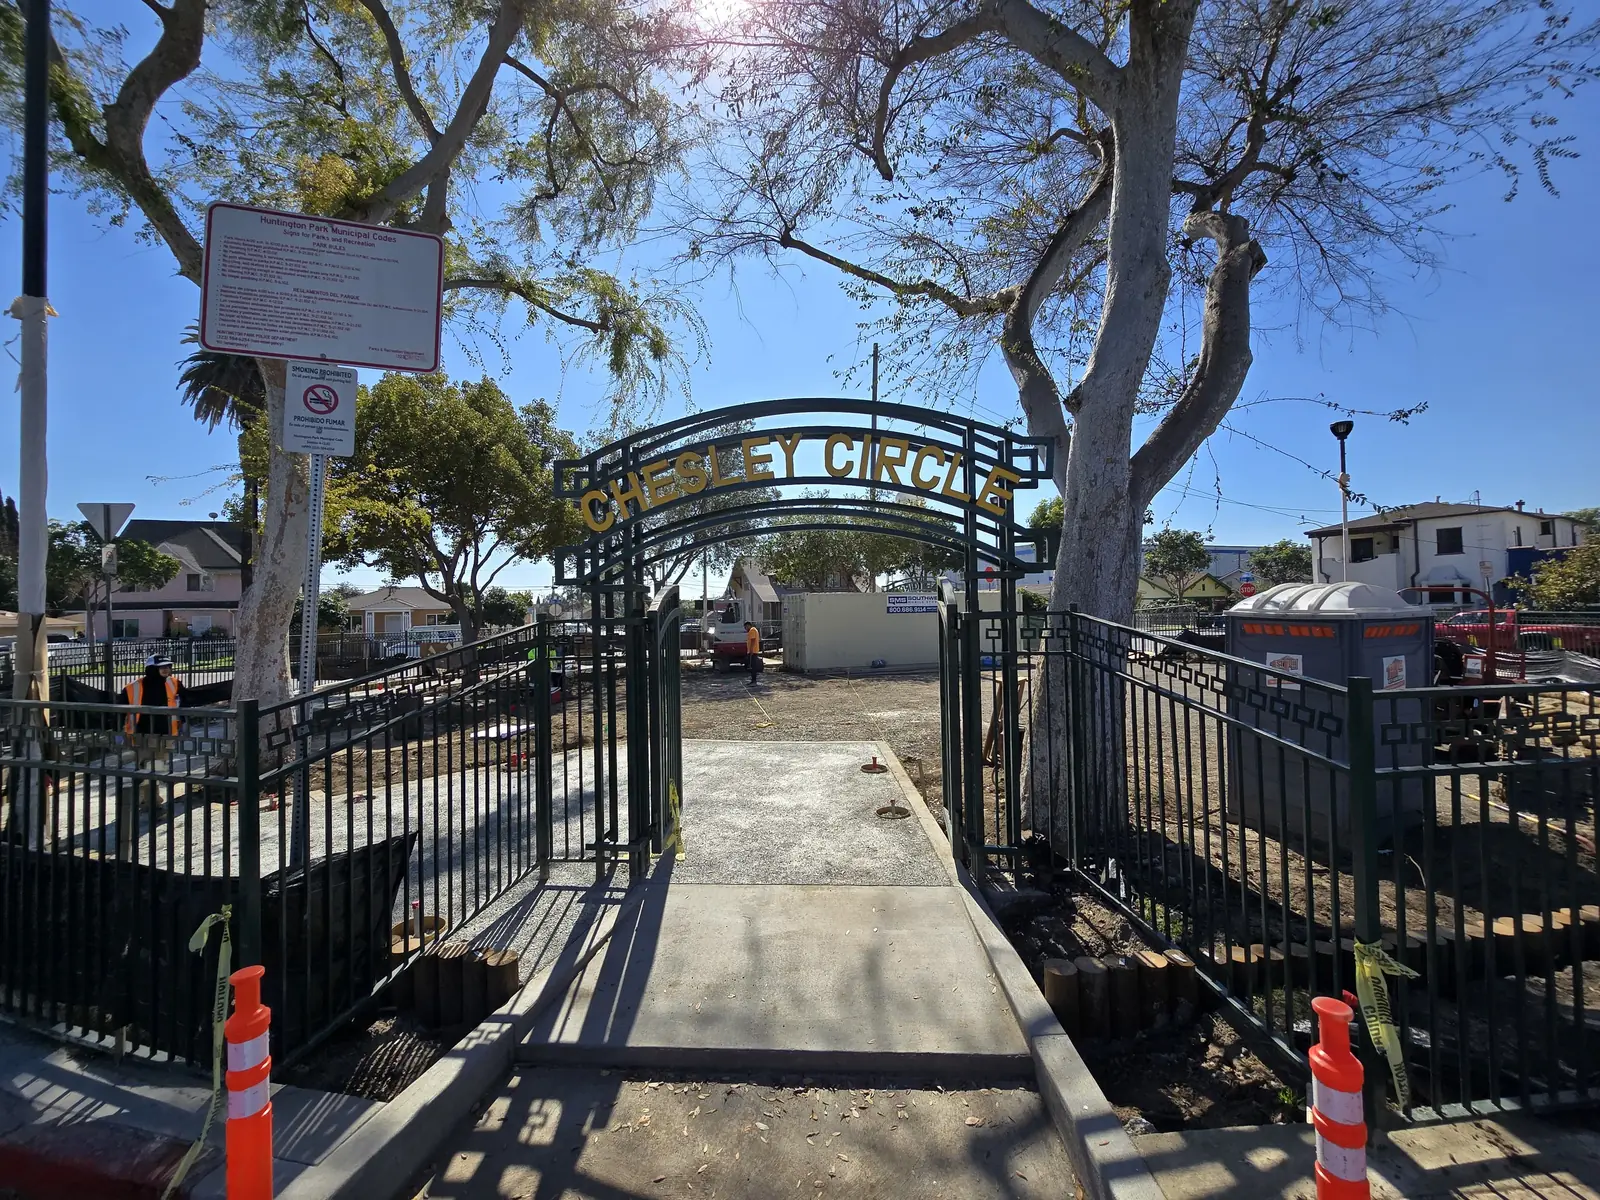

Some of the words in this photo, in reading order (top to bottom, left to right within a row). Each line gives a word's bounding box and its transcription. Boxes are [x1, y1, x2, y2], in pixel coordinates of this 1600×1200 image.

[260, 215, 307, 230] Huntington
[308, 222, 329, 233] Park
[331, 226, 370, 239] Municipal
[372, 232, 397, 243] Codes
[283, 229, 300, 237] Signs
[311, 233, 330, 241] Parks
[343, 237, 376, 248] Recreation
[312, 241, 328, 249] PARK
[291, 365, 319, 375] SMOKING
[319, 368, 352, 379] PROHIBITED
[293, 415, 325, 424] PROHIBIDO
[325, 418, 346, 426] FUMAR
[580, 432, 802, 532] CHESLEY
[825, 433, 1022, 516] CIRCLE
